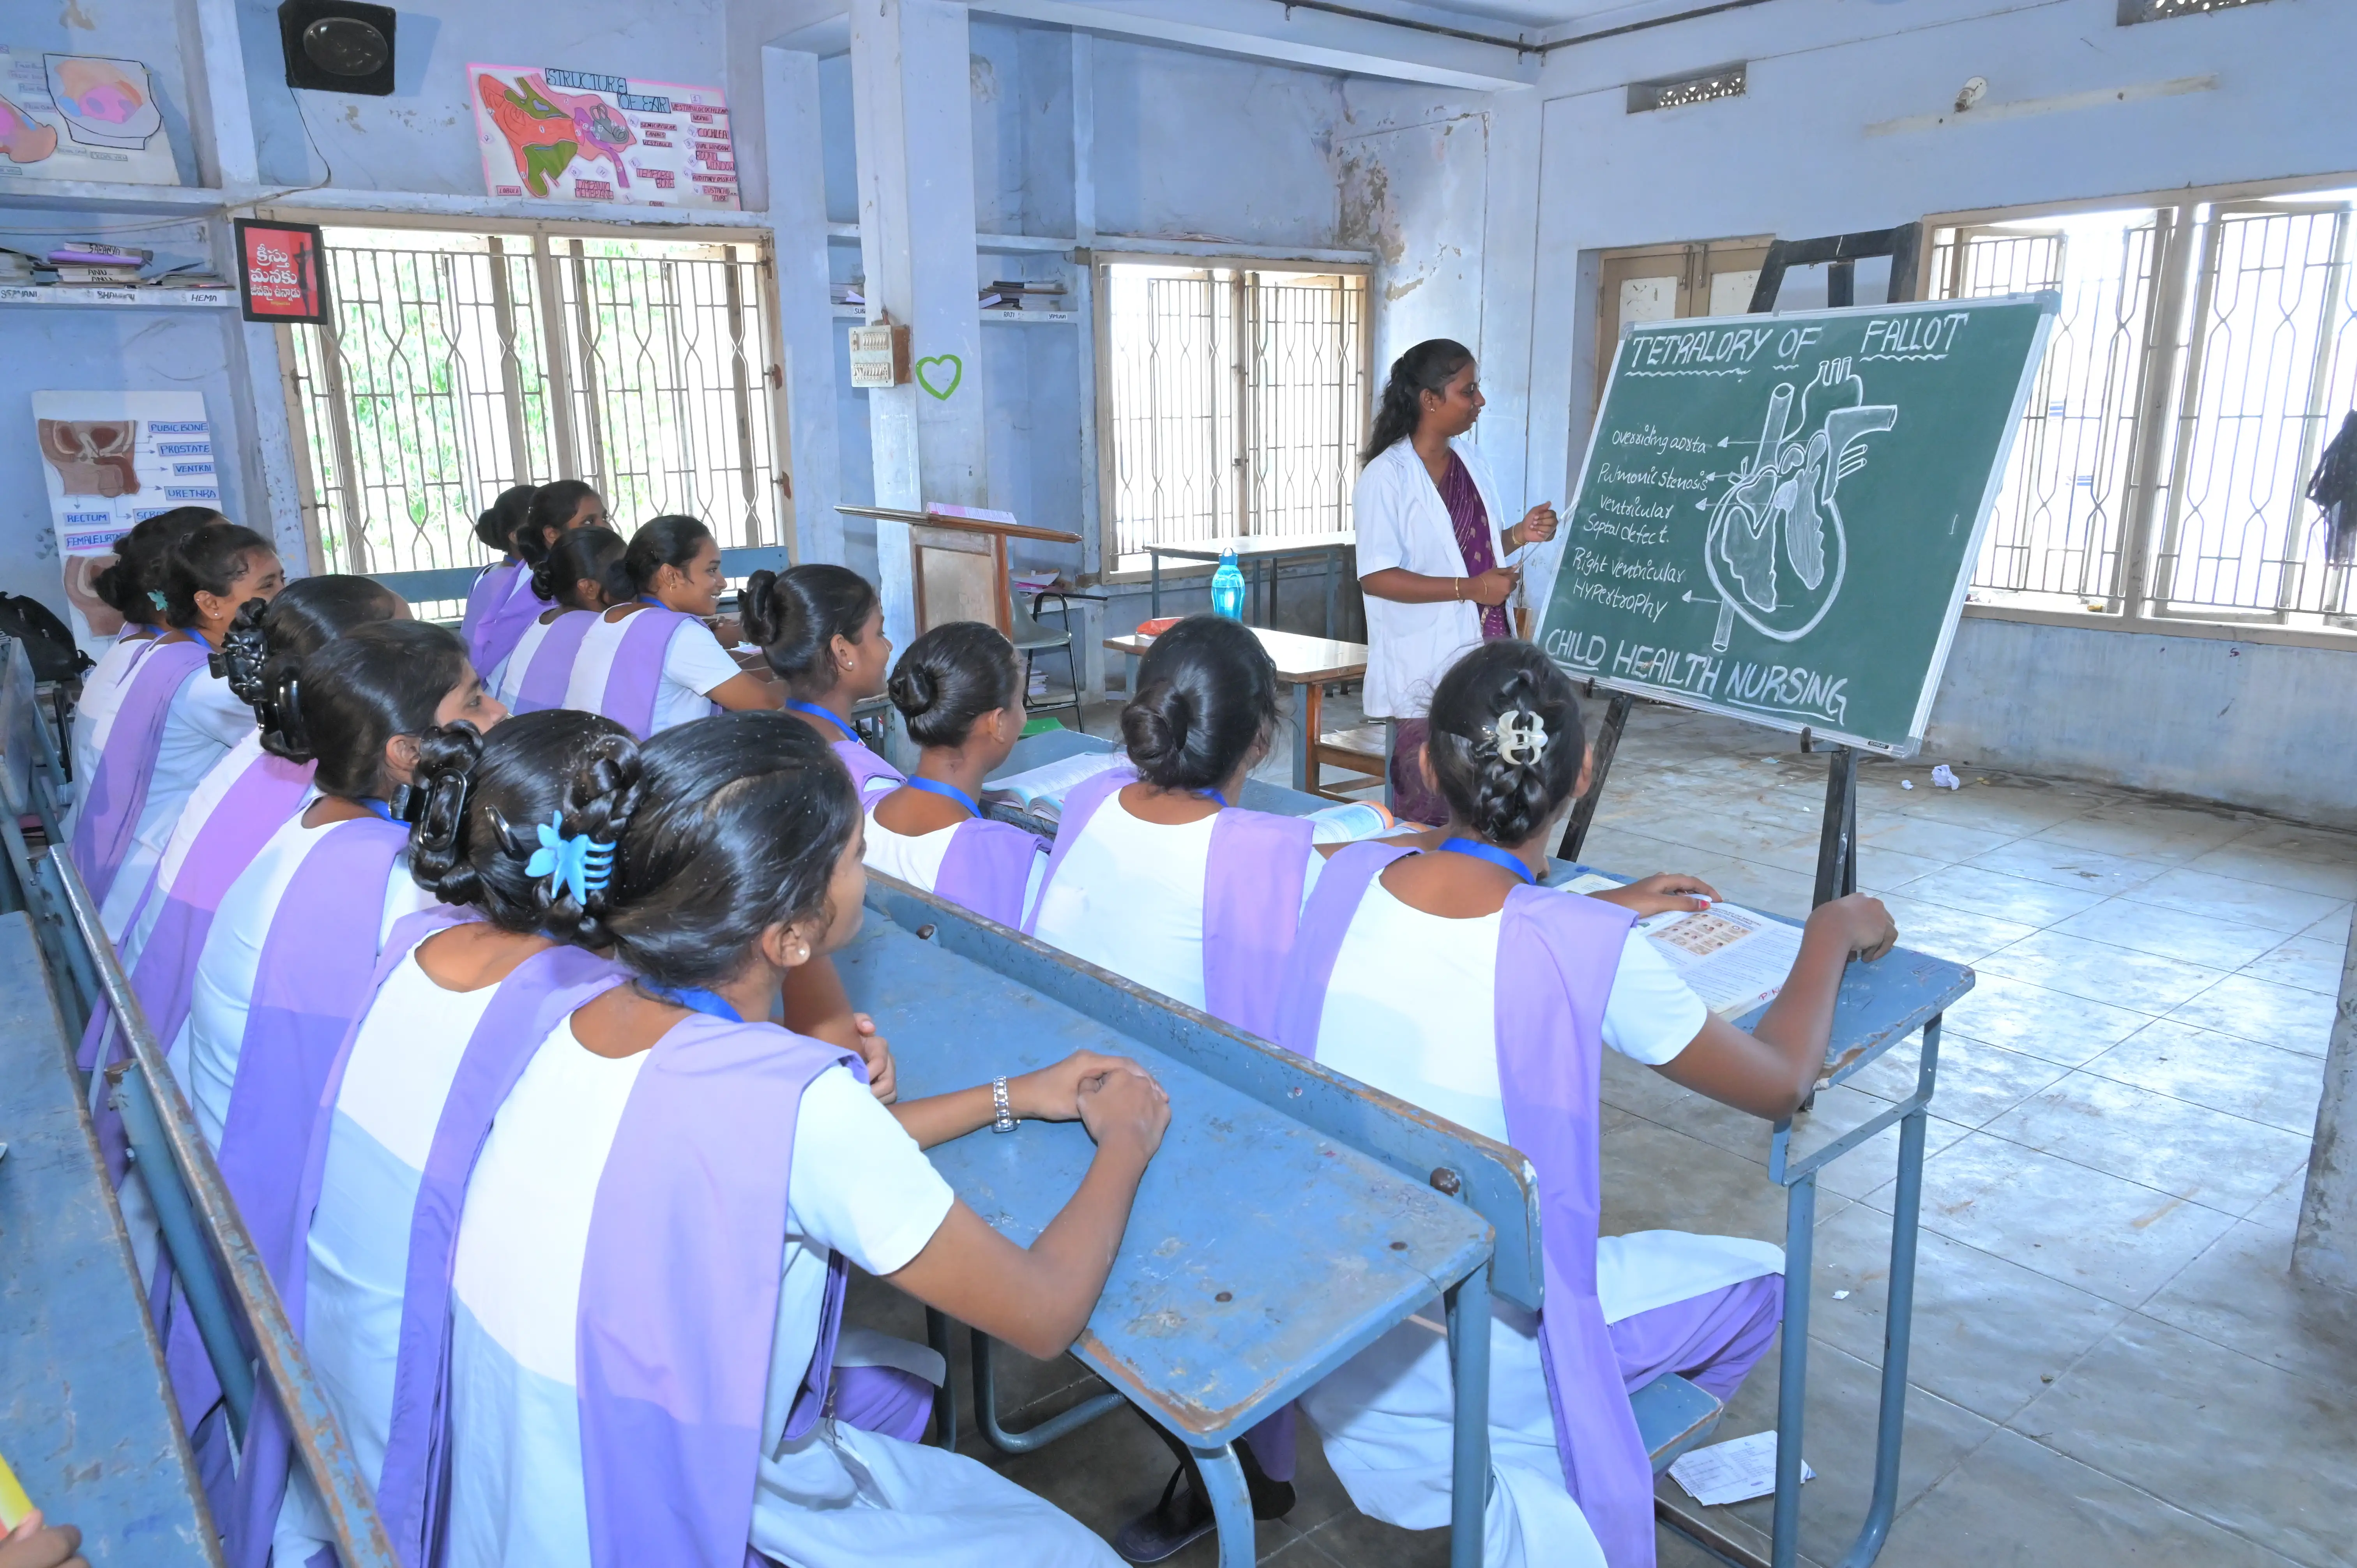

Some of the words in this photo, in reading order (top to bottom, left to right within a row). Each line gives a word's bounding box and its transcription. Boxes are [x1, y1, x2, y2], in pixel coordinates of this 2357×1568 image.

[547, 69, 626, 94] STRUCTURE
[620, 93, 636, 109] OF
[643, 96, 670, 113] EAR
[697, 128, 728, 139] COCHLEA
[250, 268, 298, 285] మనకు
[1778, 326, 1823, 359] OF
[1860, 312, 1970, 353] FALLOT
[180, 423, 208, 431] BONE
[160, 445, 210, 454] PROSTATE
[1670, 436, 1706, 454] aorta
[1597, 463, 1658, 484] Pulmonic
[168, 489, 217, 498] URETHRA
[67, 514, 107, 523] RECTUM
[67, 535, 99, 547] FEMALE
[1573, 547, 1608, 576] Right
[1545, 628, 1606, 666] CHILD
[1724, 660, 1848, 727] NURSING
